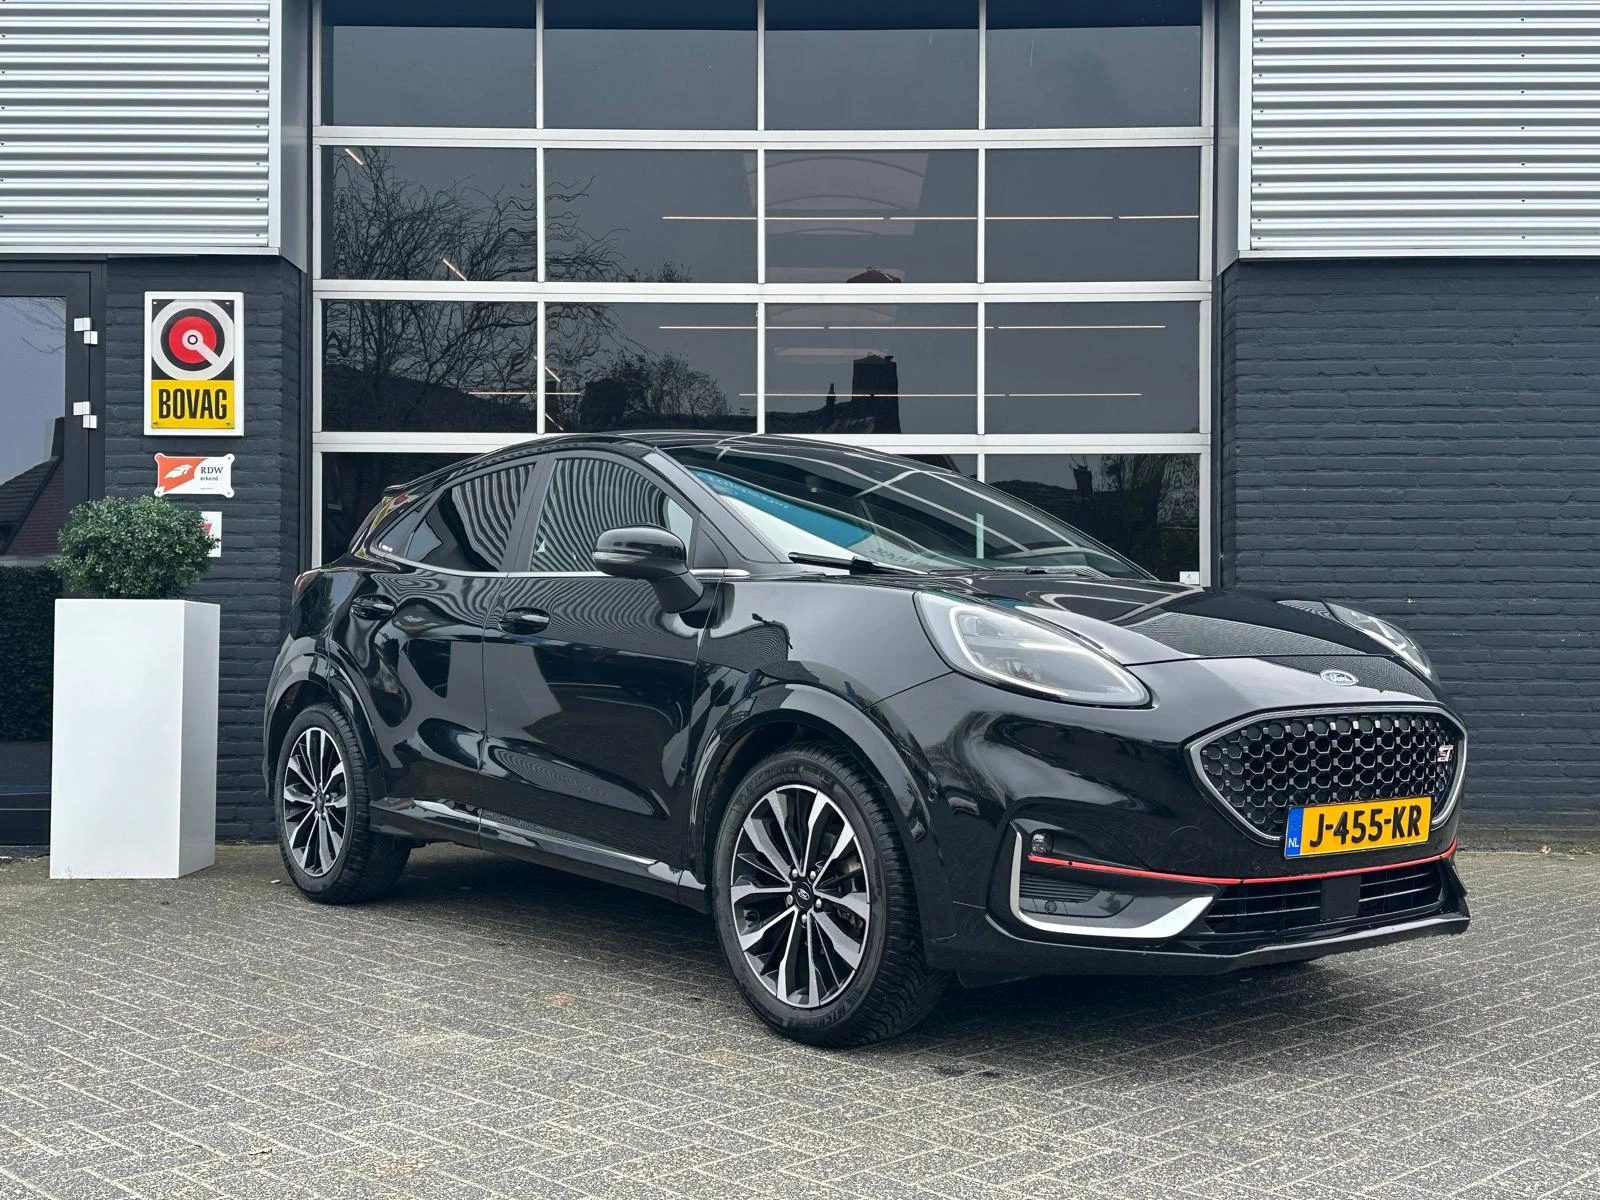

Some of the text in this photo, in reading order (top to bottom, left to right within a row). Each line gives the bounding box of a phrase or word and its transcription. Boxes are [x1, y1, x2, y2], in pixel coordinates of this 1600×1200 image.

[158, 388, 227, 420] BOVAG
[200, 466, 223, 474] RDW
[1309, 804, 1422, 848] J-455-KR
[1288, 837, 1300, 848] NL
